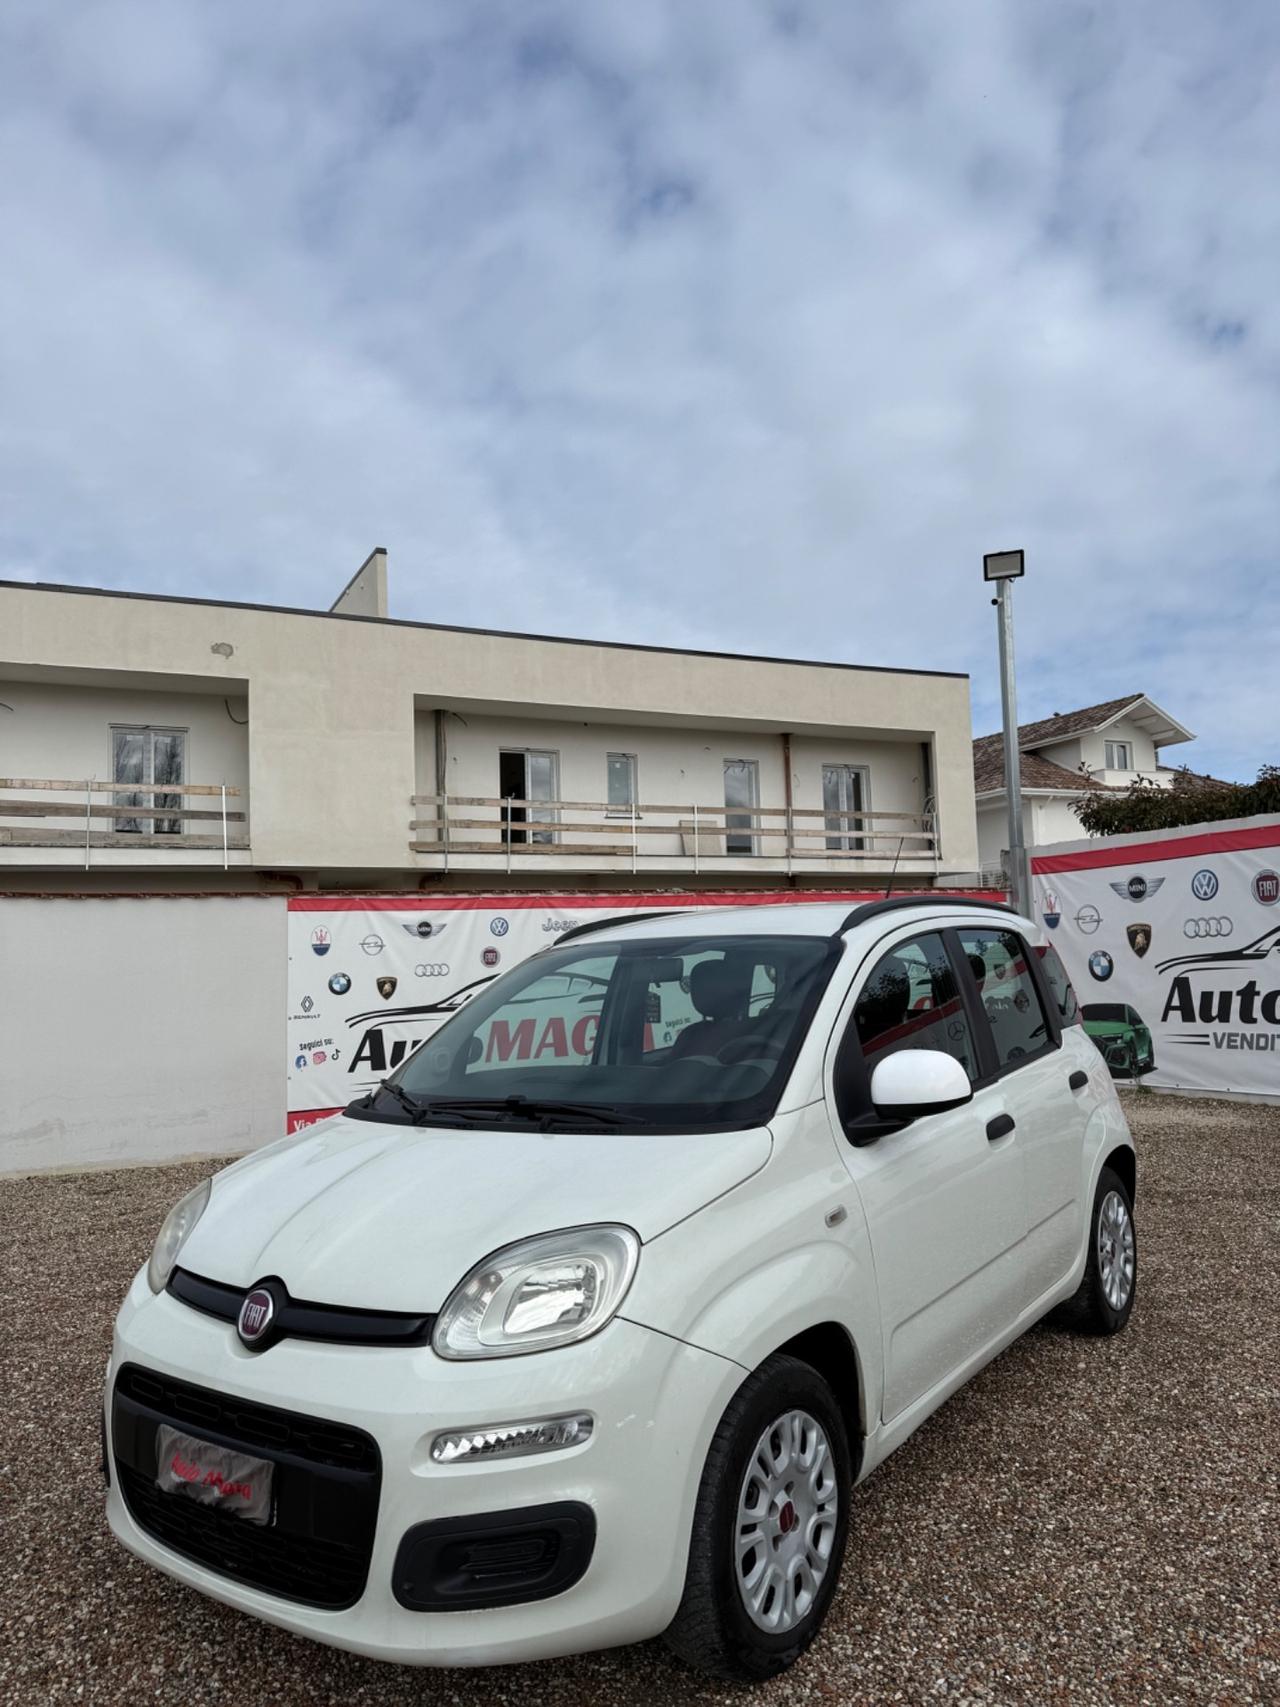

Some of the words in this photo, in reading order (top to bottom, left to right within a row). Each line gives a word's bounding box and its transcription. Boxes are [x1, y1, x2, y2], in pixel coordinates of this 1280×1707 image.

[1129, 883, 1146, 892] MINI
[1258, 880, 1278, 897] FIAT
[244, 1303, 267, 1328] FIAT
